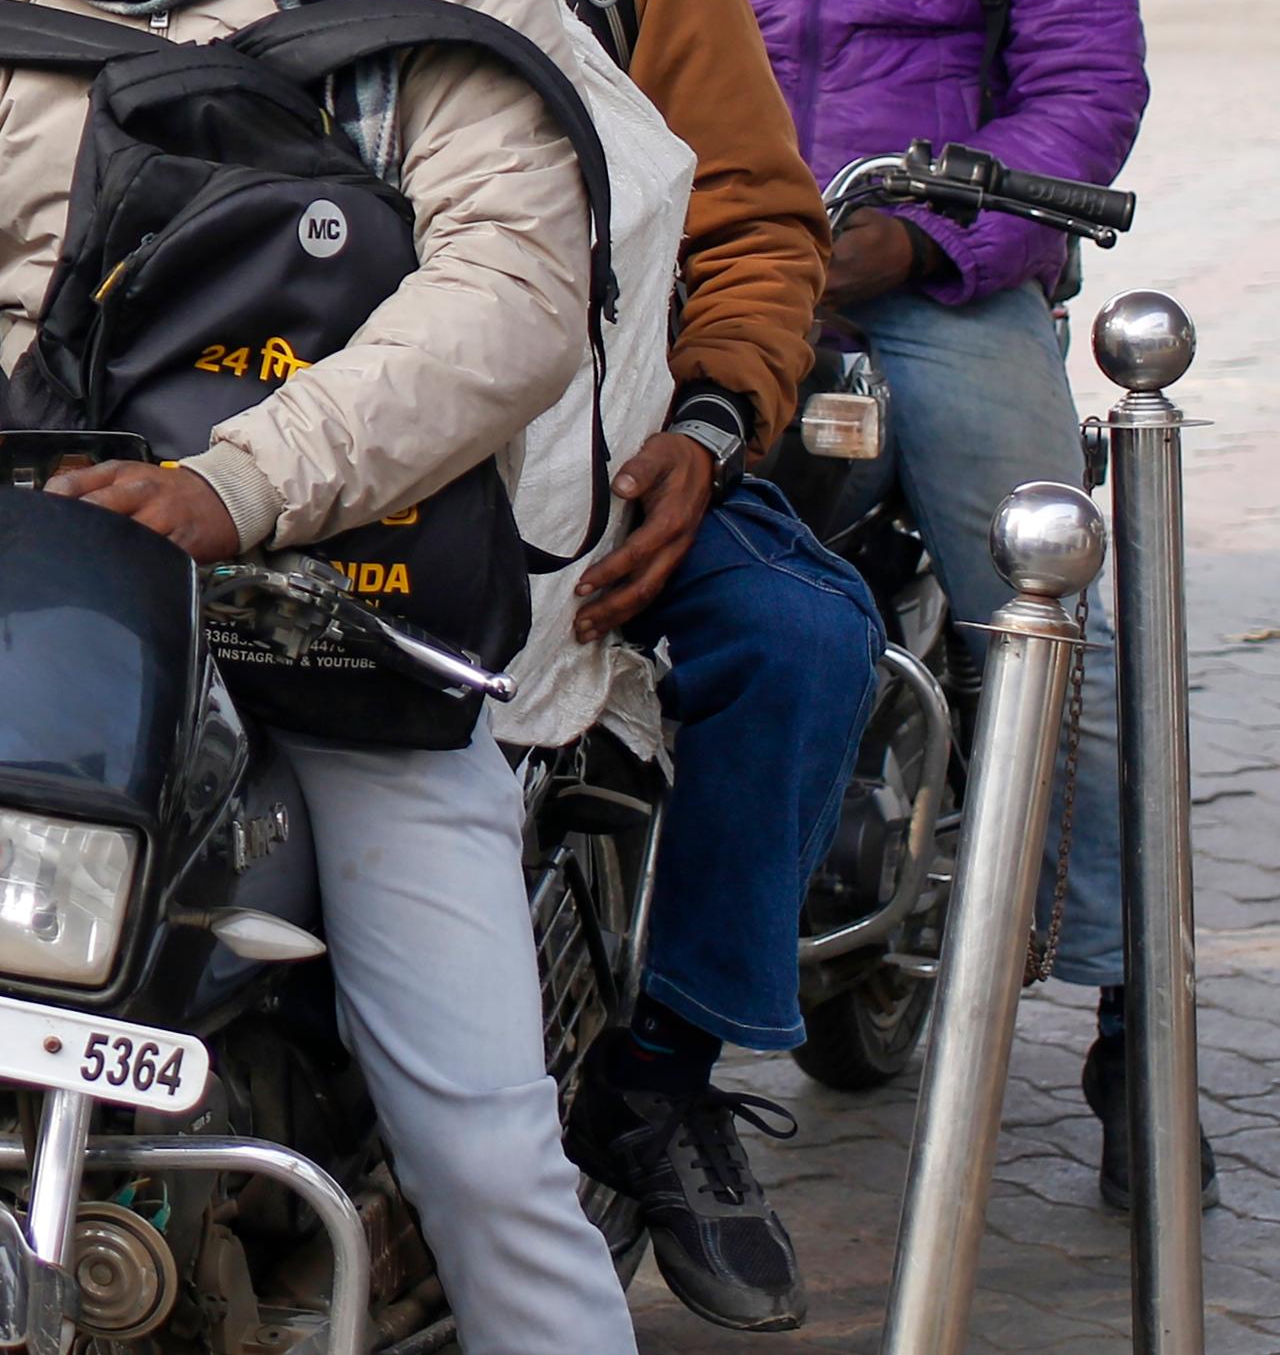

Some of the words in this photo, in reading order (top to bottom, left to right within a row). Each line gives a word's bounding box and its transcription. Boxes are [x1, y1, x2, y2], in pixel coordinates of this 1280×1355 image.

[308, 217, 340, 241] MC
[194, 345, 249, 377] 24
[218, 648, 293, 666] INSTAGR
[300, 656, 311, 667] &
[80, 1033, 185, 1095] 5364
